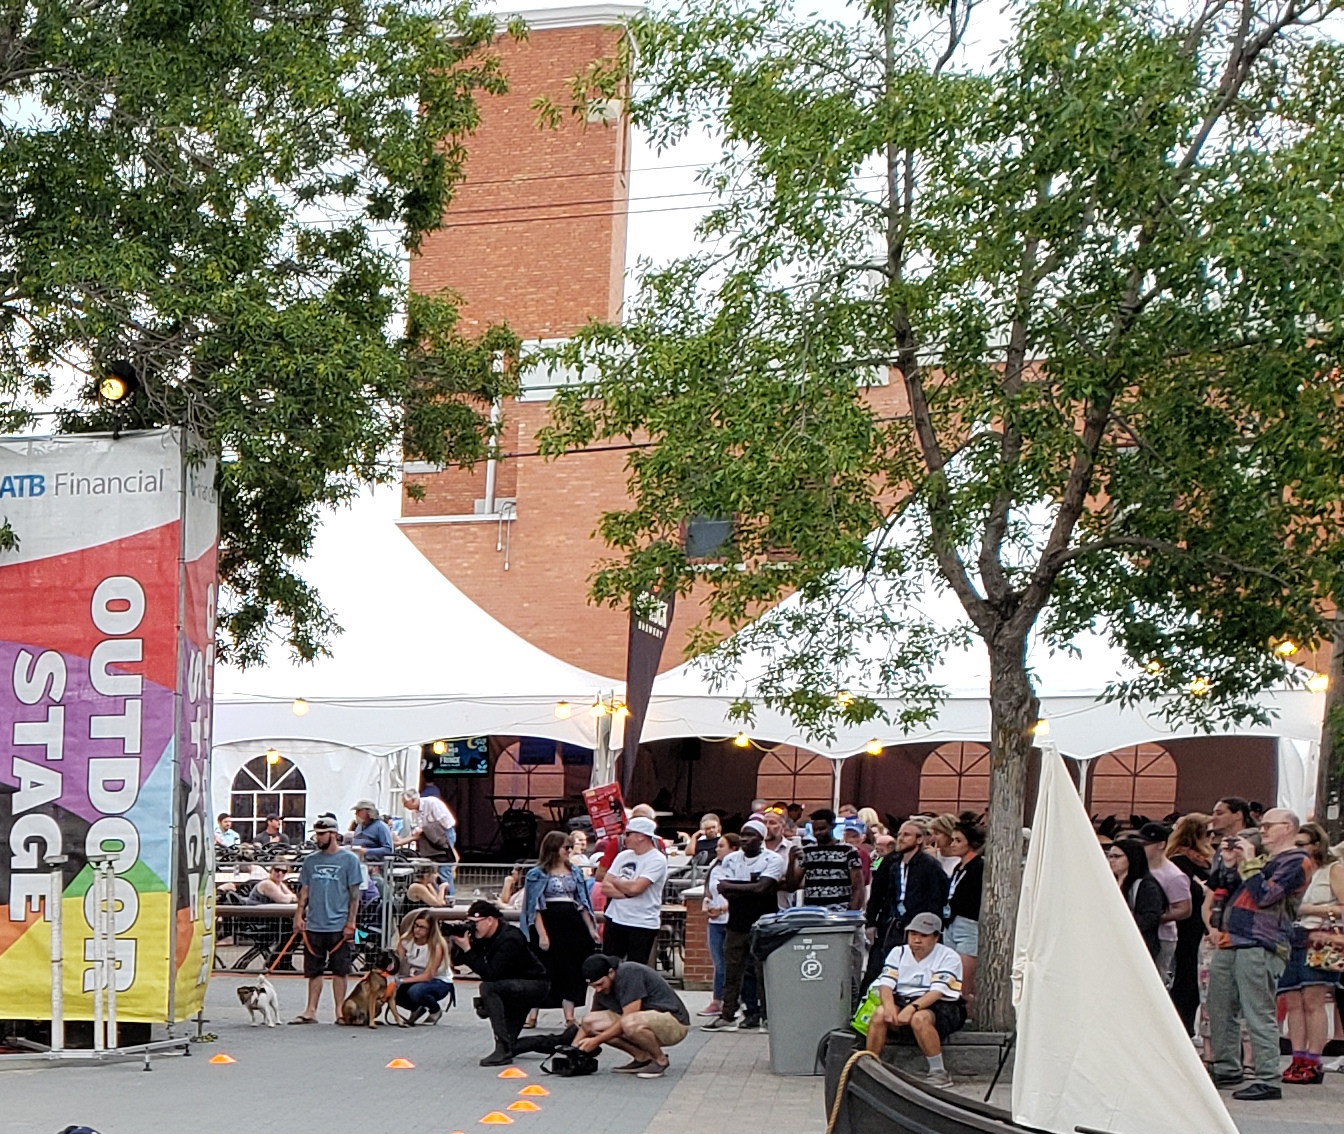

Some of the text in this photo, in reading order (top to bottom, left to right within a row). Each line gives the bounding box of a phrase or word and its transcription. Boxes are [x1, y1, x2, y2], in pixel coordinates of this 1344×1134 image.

[54, 468, 164, 496] Financial
[8, 650, 69, 924] STAGE
[81, 575, 147, 995] OUTDOOR
